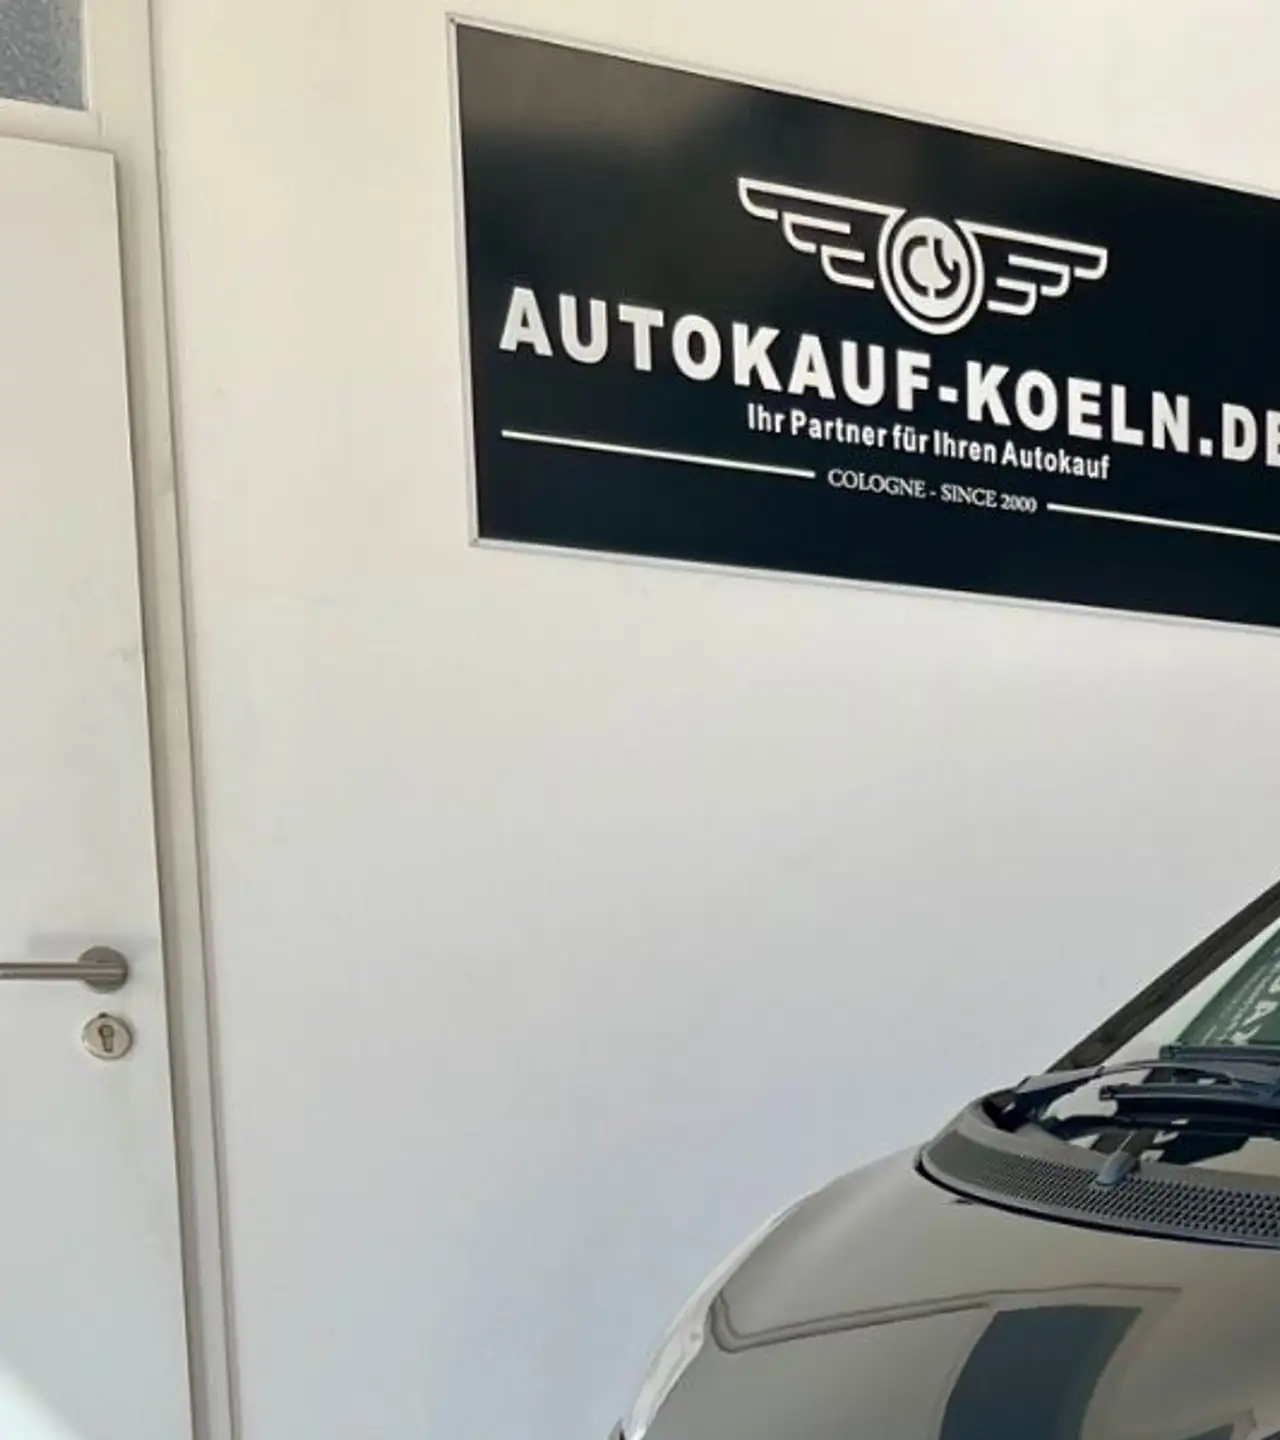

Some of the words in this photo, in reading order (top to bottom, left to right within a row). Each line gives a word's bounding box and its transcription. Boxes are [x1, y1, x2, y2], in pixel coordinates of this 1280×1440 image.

[747, 402, 786, 433] Ihr
[790, 409, 887, 448] Partner
[892, 423, 930, 455] für
[933, 429, 997, 465] Ihren
[1000, 440, 1111, 481] Autokauf
[826, 467, 927, 499] COLOGNE
[940, 484, 998, 510] SINCE
[999, 493, 1039, 514] 2000
